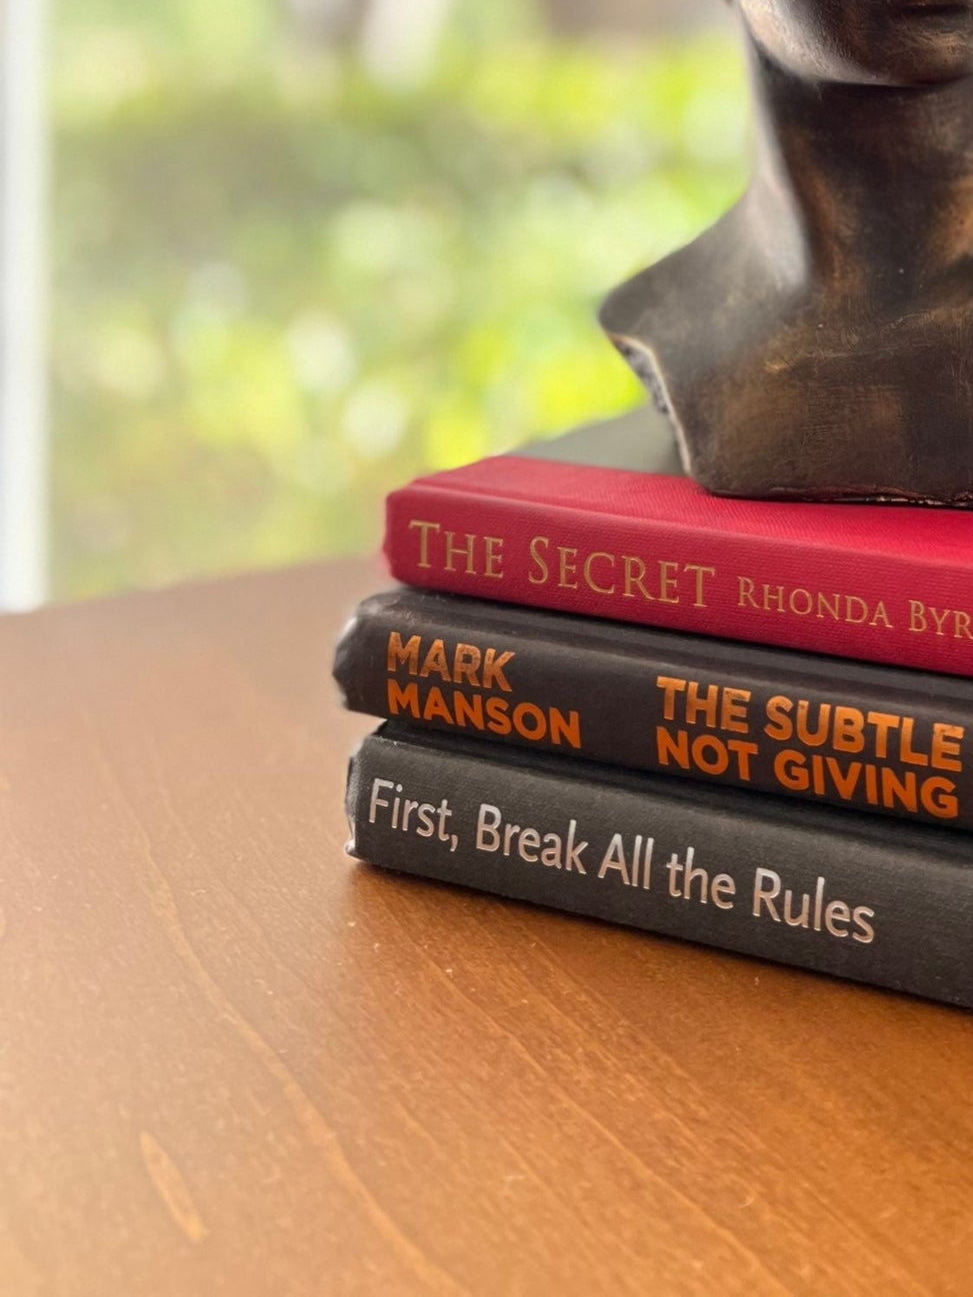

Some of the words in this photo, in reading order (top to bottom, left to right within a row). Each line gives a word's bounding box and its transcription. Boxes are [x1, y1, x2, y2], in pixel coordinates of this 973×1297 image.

[409, 519, 504, 579] THE
[529, 537, 716, 608] SECRET
[738, 577, 893, 629] RHONDA
[386, 631, 516, 692] MARK
[386, 678, 582, 749] MANSON
[656, 676, 751, 734] THE
[764, 695, 965, 773] SUBTLE
[656, 725, 758, 781] NOT
[774, 749, 958, 819] GIVING
[367, 778, 458, 853] First,
[475, 803, 588, 875] Break
[597, 834, 654, 890] All
[667, 847, 736, 910] the
[752, 868, 876, 945] Rules
